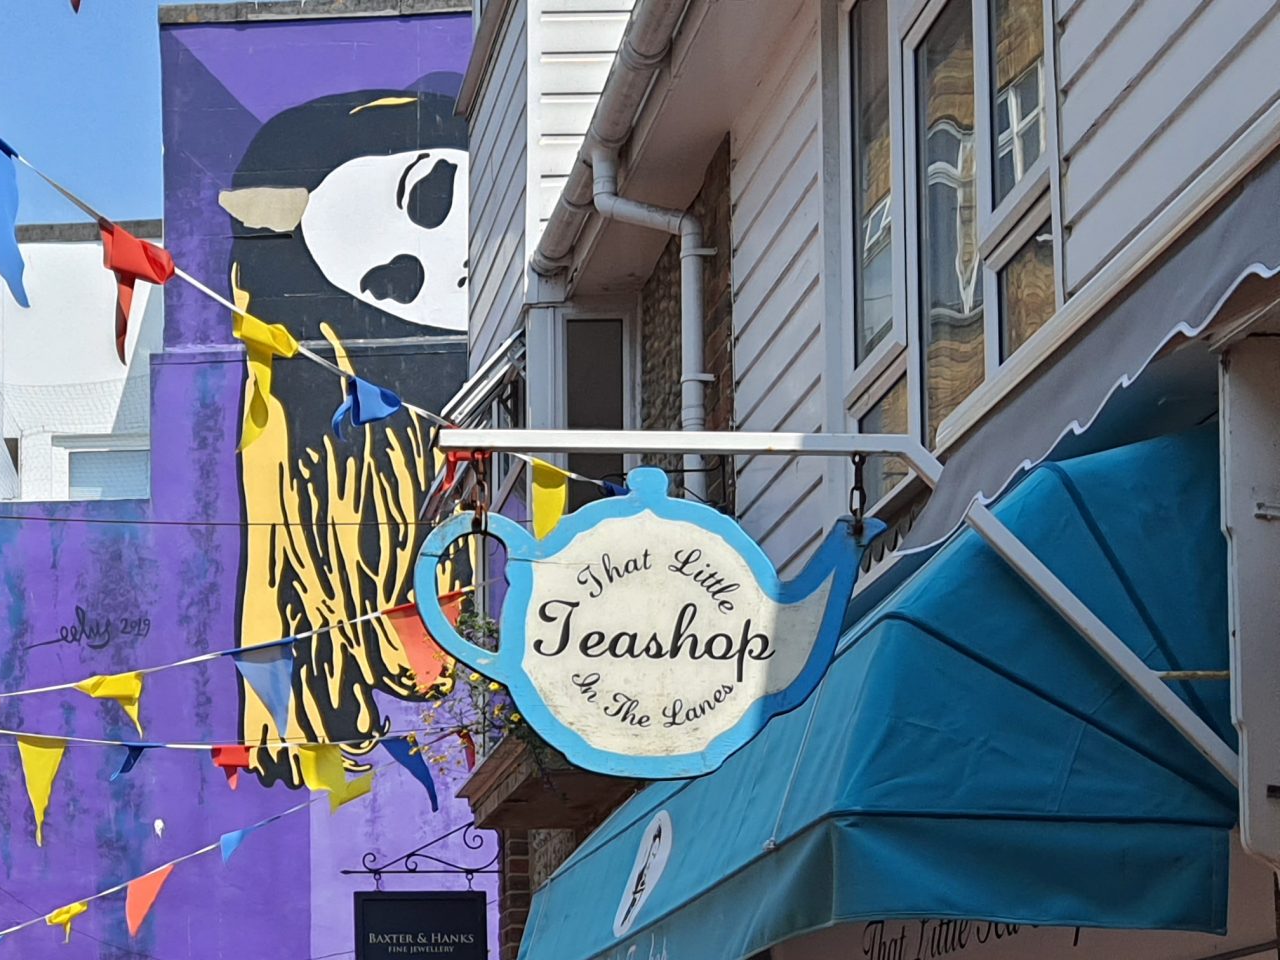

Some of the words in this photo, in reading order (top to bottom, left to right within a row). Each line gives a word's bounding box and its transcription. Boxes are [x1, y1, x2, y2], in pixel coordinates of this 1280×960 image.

[577, 549, 651, 598] That
[668, 549, 740, 614] Little
[532, 599, 776, 683] Teashop
[572, 673, 601, 703] In
[604, 692, 651, 728] The
[662, 683, 734, 728] Lanes
[369, 933, 413, 944] BAXTER
[417, 933, 428, 944] &
[431, 933, 474, 944] HANKS
[410, 946, 454, 954] JEWELLERY
